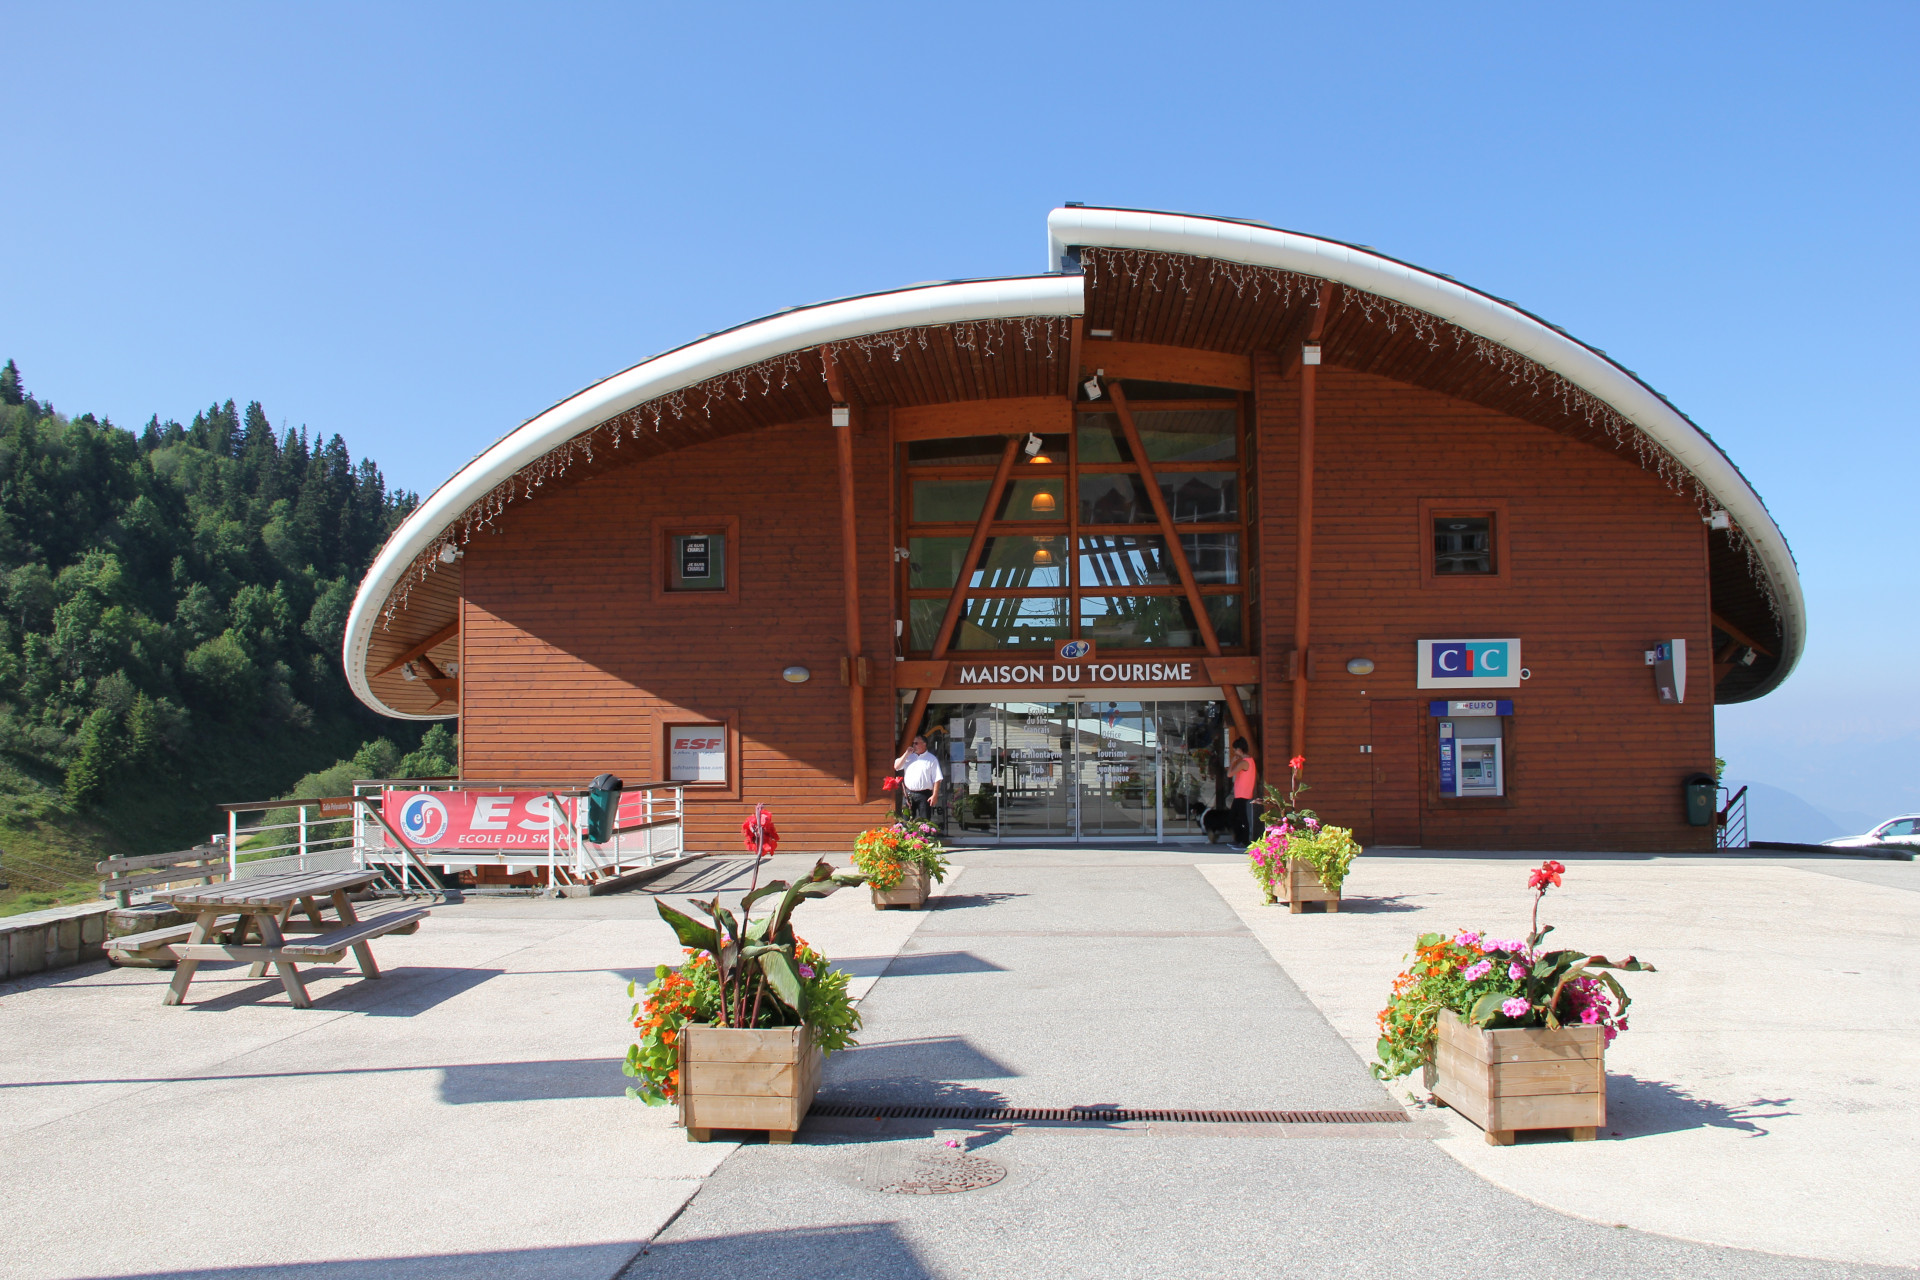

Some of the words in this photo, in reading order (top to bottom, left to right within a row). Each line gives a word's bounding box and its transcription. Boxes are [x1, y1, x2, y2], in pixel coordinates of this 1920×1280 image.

[1438, 649, 1500, 671] CIC
[960, 665, 1044, 684] MAISON
[1052, 664, 1080, 683] DU
[1088, 663, 1192, 682] TOURISME
[1026, 716, 1035, 725] du
[1102, 730, 1121, 739] Office
[674, 738, 722, 749] ESF
[1107, 740, 1117, 748] du
[1011, 749, 1019, 758] de
[1020, 750, 1027, 758] la
[1097, 749, 1127, 757] Tourisme
[1029, 765, 1045, 774] Club
[457, 833, 502, 843] ECOLE
[505, 833, 528, 843] DU
[531, 833, 553, 843] SK
